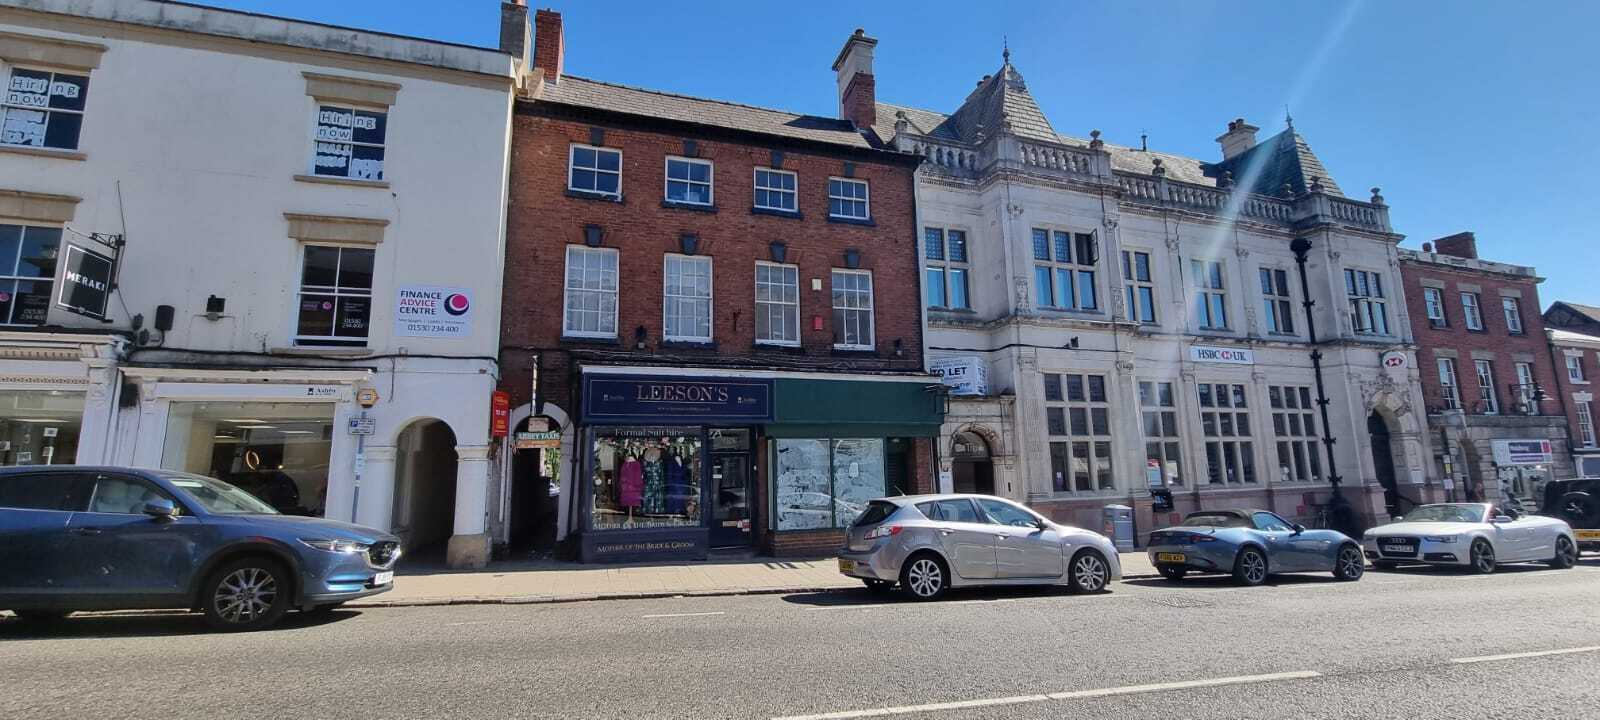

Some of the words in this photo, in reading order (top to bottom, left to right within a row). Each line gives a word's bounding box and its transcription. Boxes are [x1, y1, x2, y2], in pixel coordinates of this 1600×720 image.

[12, 78, 76, 97] Hiring
[10, 94, 45, 105] now
[322, 113, 374, 129] Hiring
[319, 128, 350, 139] now
[67, 271, 105, 291] MERAKI
[400, 290, 442, 300] FINANCE
[400, 298, 436, 308] ADVICE
[399, 306, 436, 316] CENTRE
[432, 325, 445, 333] 234
[1198, 349, 1221, 360] HSBC
[1233, 351, 1247, 362] UK
[949, 367, 967, 377] LET
[637, 384, 729, 402] LEESON'S
[615, 428, 647, 437] Formal
